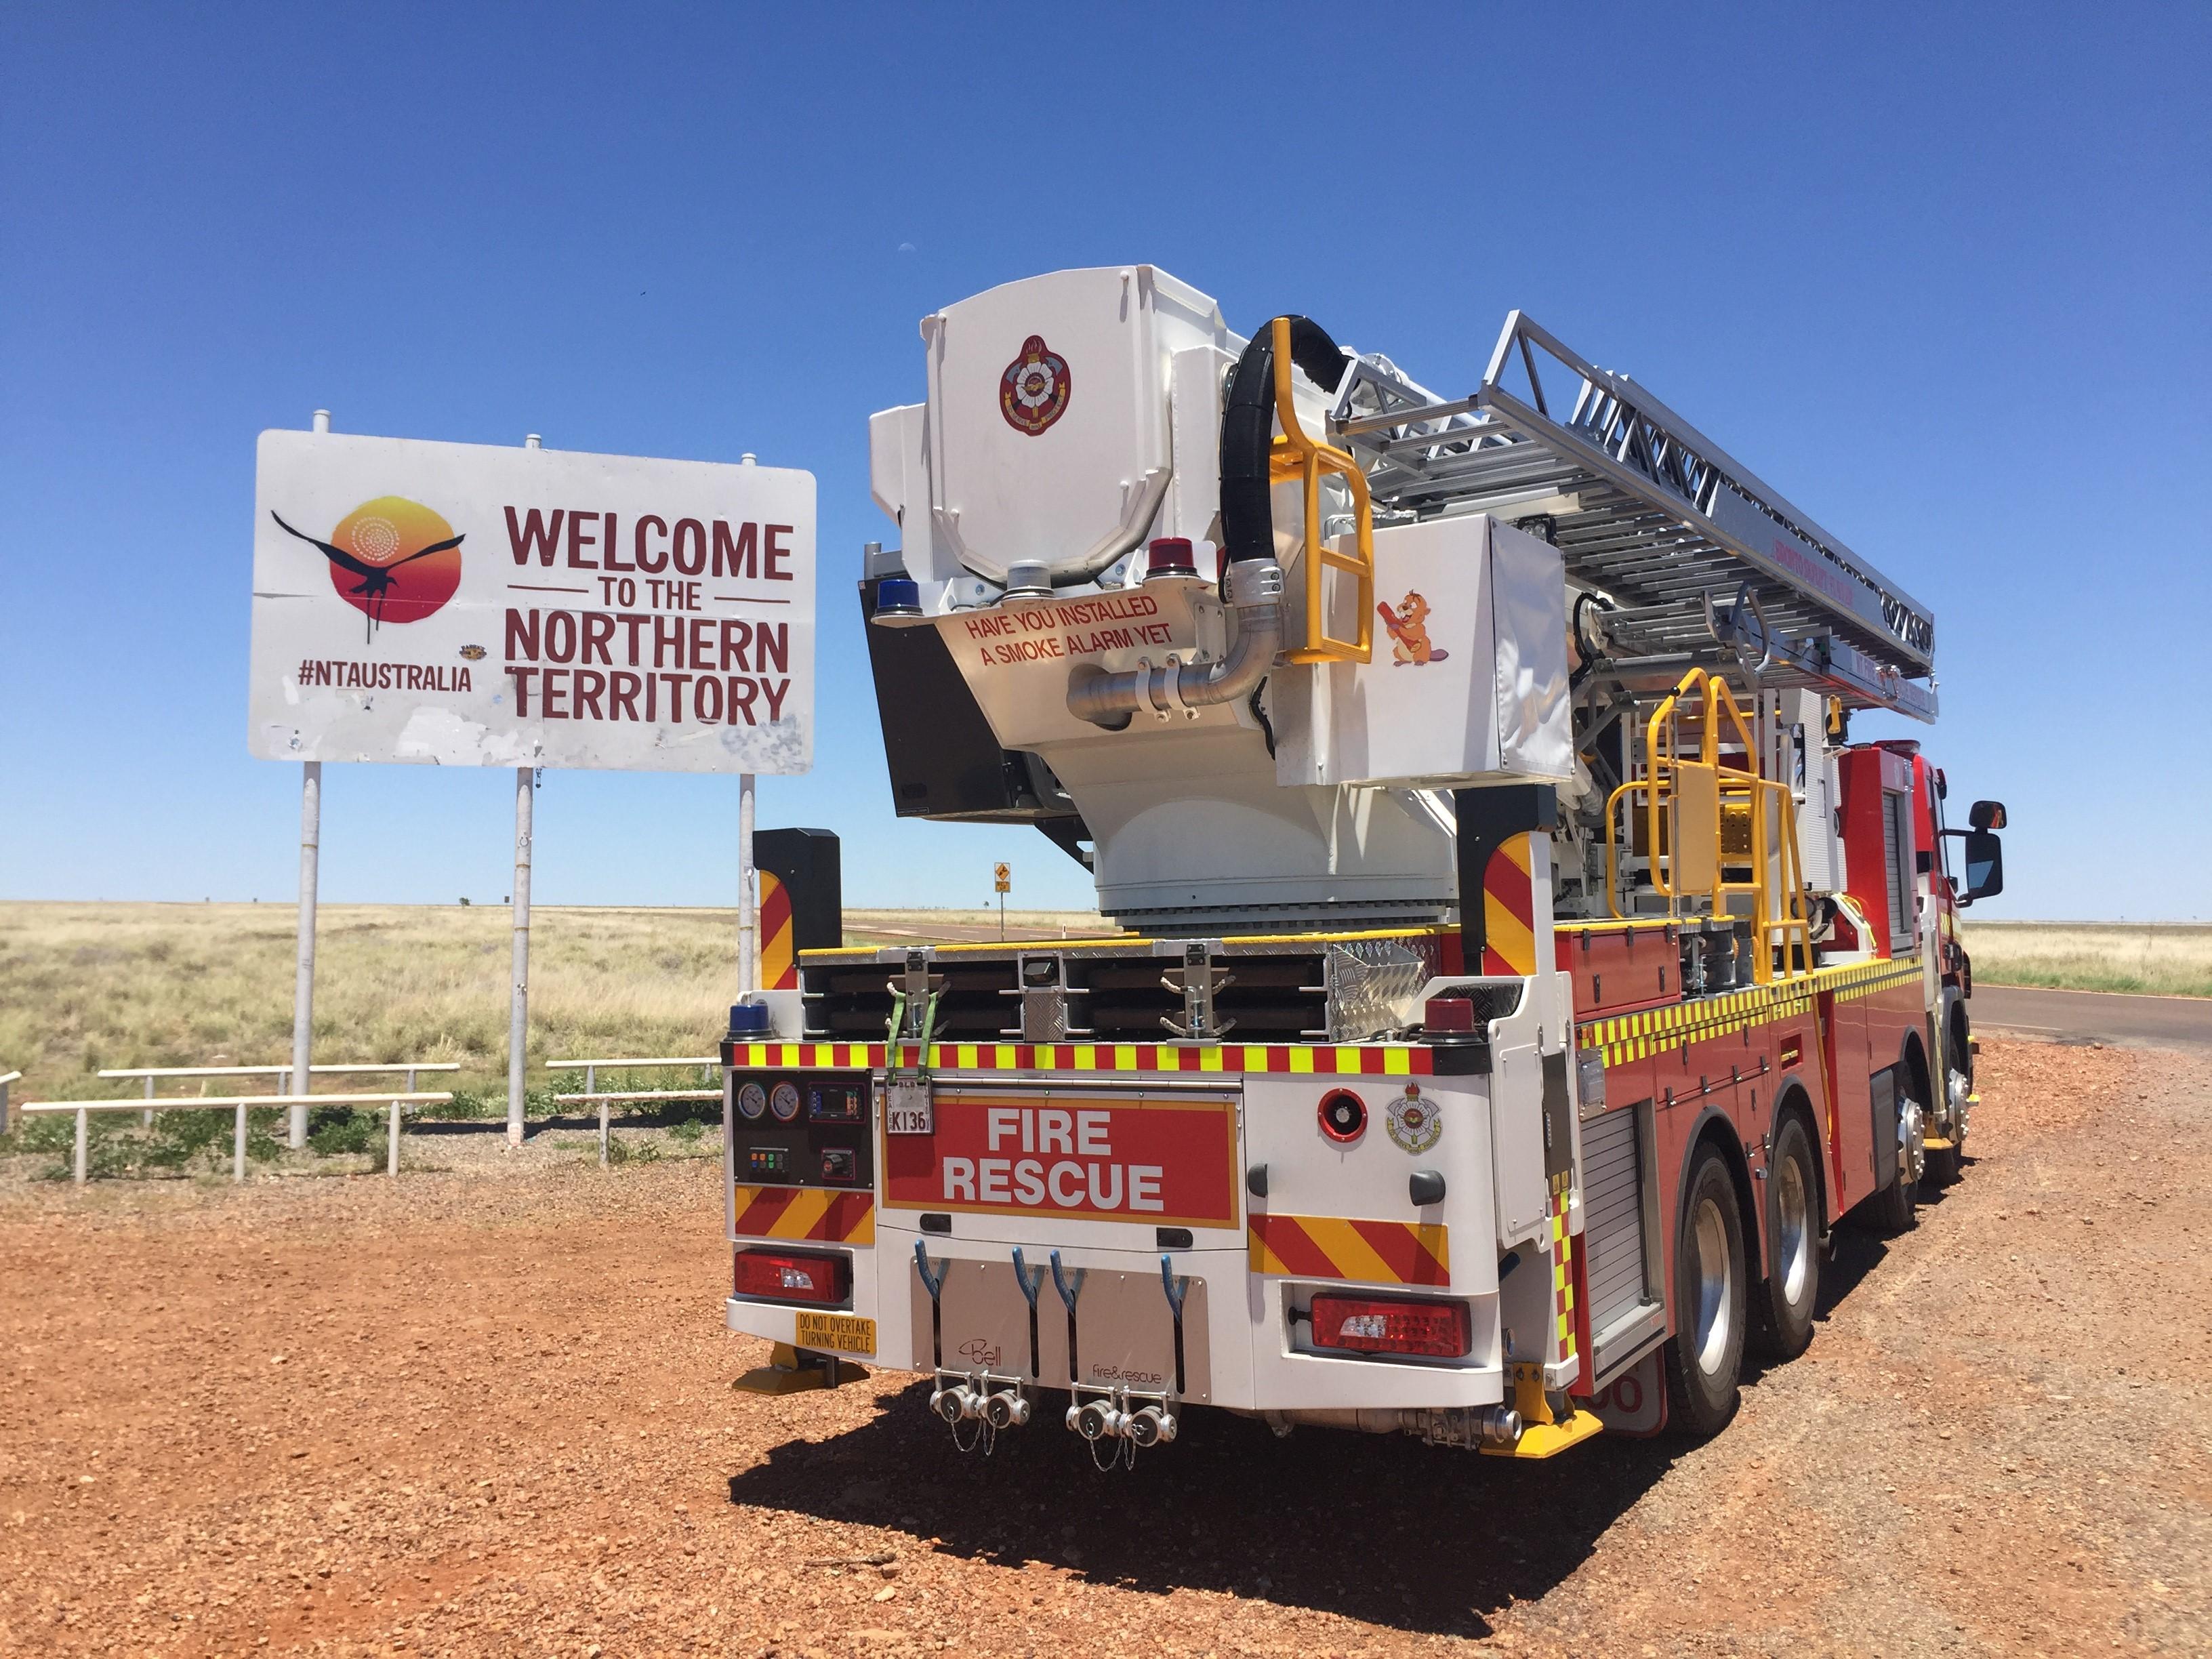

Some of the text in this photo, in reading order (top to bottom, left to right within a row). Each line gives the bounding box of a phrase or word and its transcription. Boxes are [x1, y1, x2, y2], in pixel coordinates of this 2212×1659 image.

[504, 506, 794, 581] WELCOME
[598, 576, 701, 611] TO THE
[964, 595, 1158, 639] HAVE YOU INSTALLED
[505, 609, 788, 673] NORTHERN
[980, 623, 1173, 666] A SMOKE ALARM YET
[298, 659, 472, 692] #NTAUSTRALIA
[505, 666, 792, 726] TERRITORY
[988, 1108, 1111, 1155] FIRE
[943, 1156, 1164, 1211] RESCUE
[800, 1313, 872, 1336] DO NOT OVERTAKE
[801, 1330, 871, 1353] TURNING VEHICLE
[958, 1338, 1002, 1367] Bell
[1092, 1364, 1162, 1385] fire&rescue
